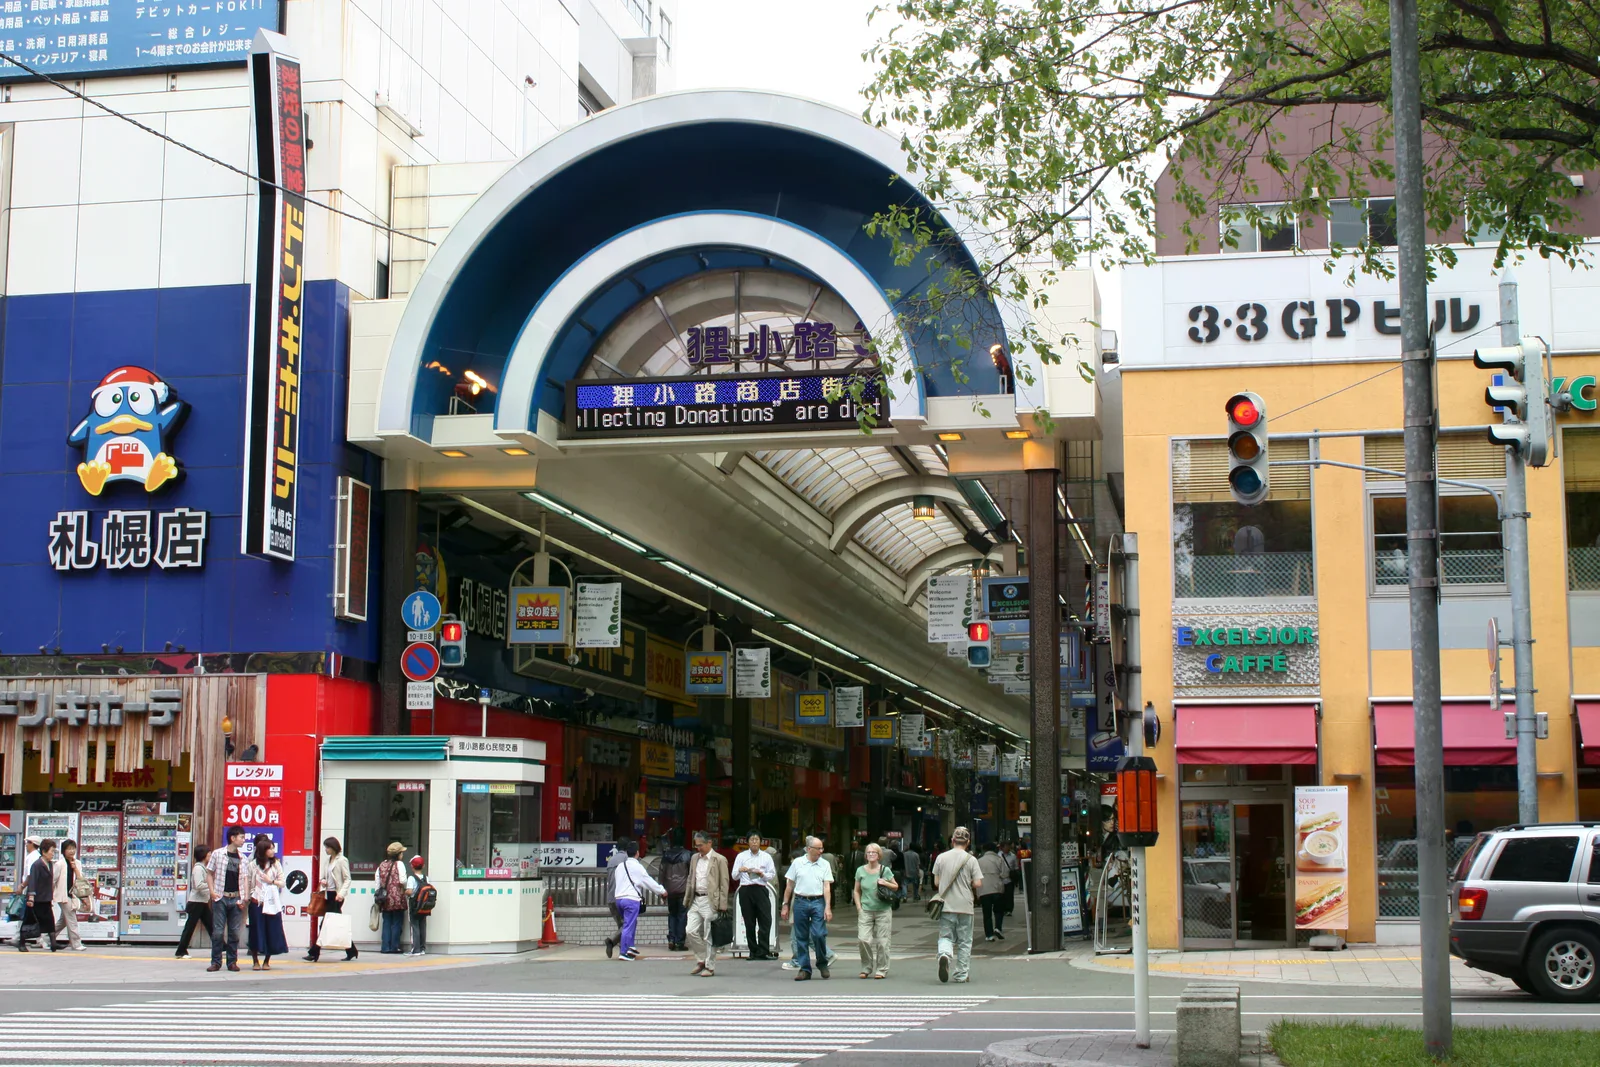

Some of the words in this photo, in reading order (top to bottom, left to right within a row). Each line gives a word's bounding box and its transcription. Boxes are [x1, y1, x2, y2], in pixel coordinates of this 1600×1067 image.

[281, 64, 304, 193] 激安の殿堂
[795, 404, 829, 420] are
[48, 508, 206, 570] 札幌店
[460, 578, 508, 640] 札幌店
[1009, 622, 1017, 632] 3
[1176, 626, 1315, 647] EXCELSIOR
[1206, 650, 1288, 673] CAFFÉ
[235, 767, 275, 778] レンタル
[233, 786, 261, 797] DVD
